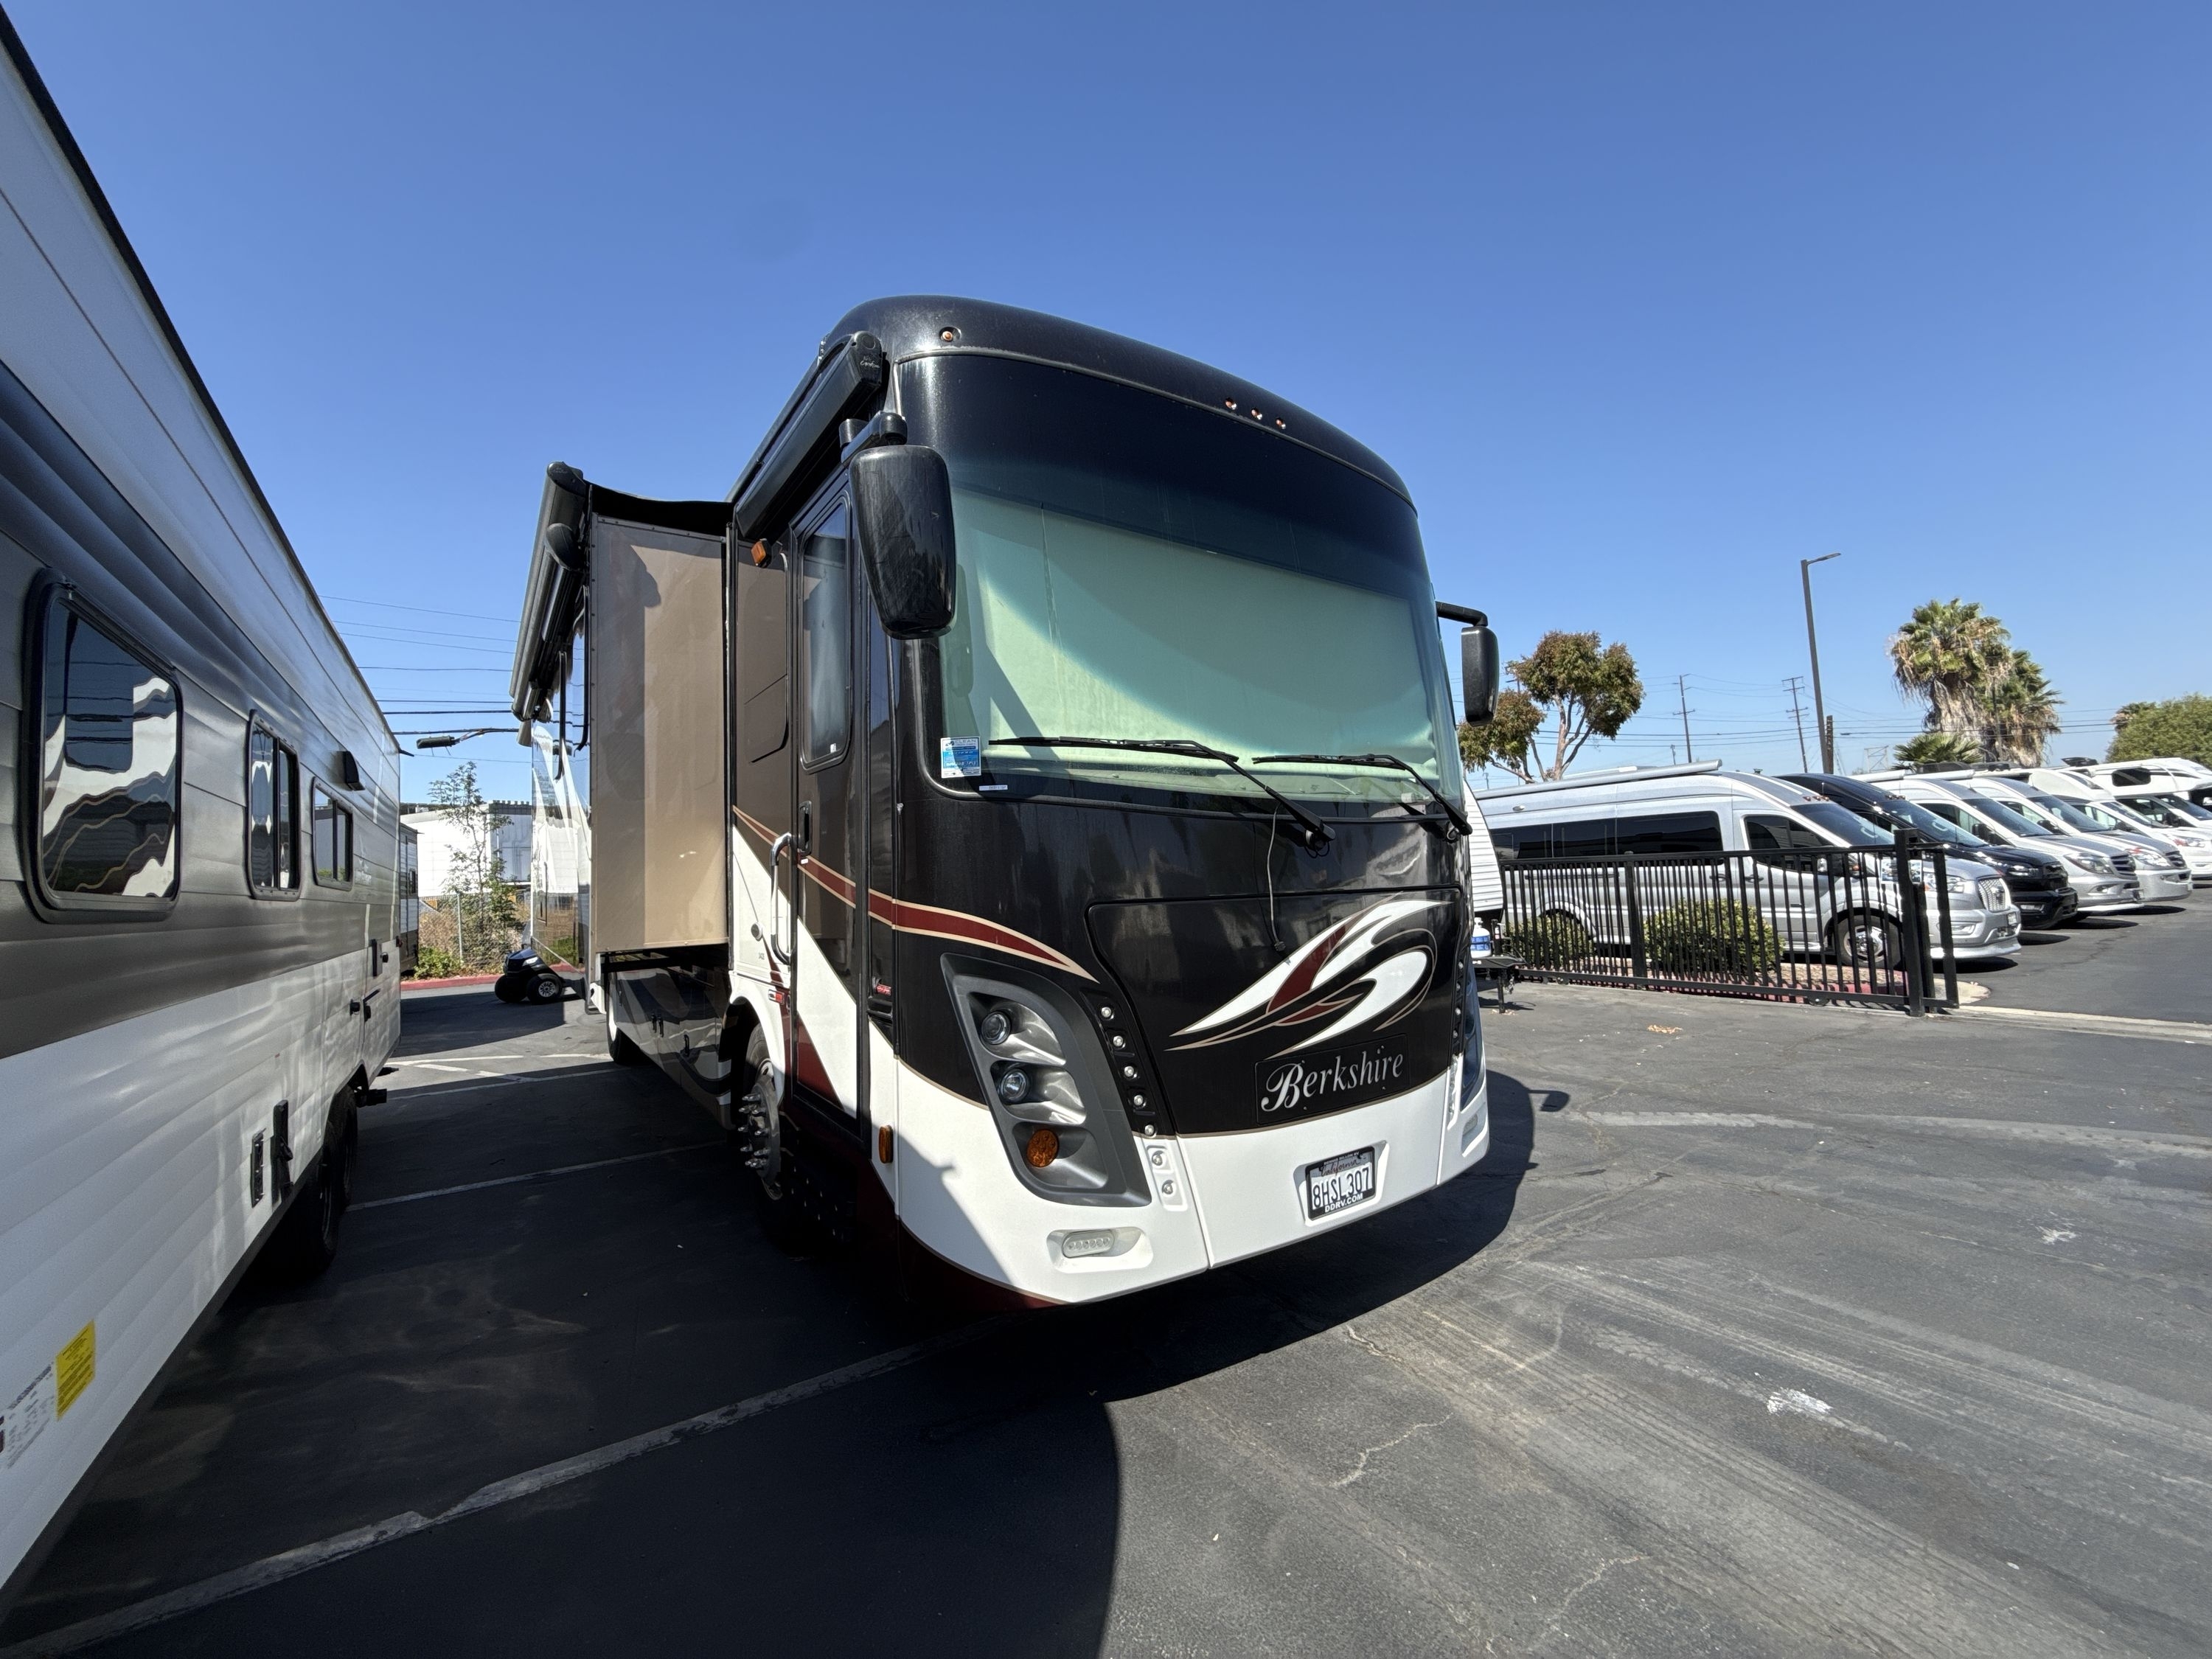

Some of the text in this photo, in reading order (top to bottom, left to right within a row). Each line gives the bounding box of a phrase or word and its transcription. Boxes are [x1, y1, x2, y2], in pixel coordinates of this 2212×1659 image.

[1261, 1048, 1404, 1112] Berkshire
[1320, 1158, 1360, 1178] California
[1312, 1167, 1369, 1208] 8HSL307
[1324, 1192, 1363, 1213] DDRV.COM
